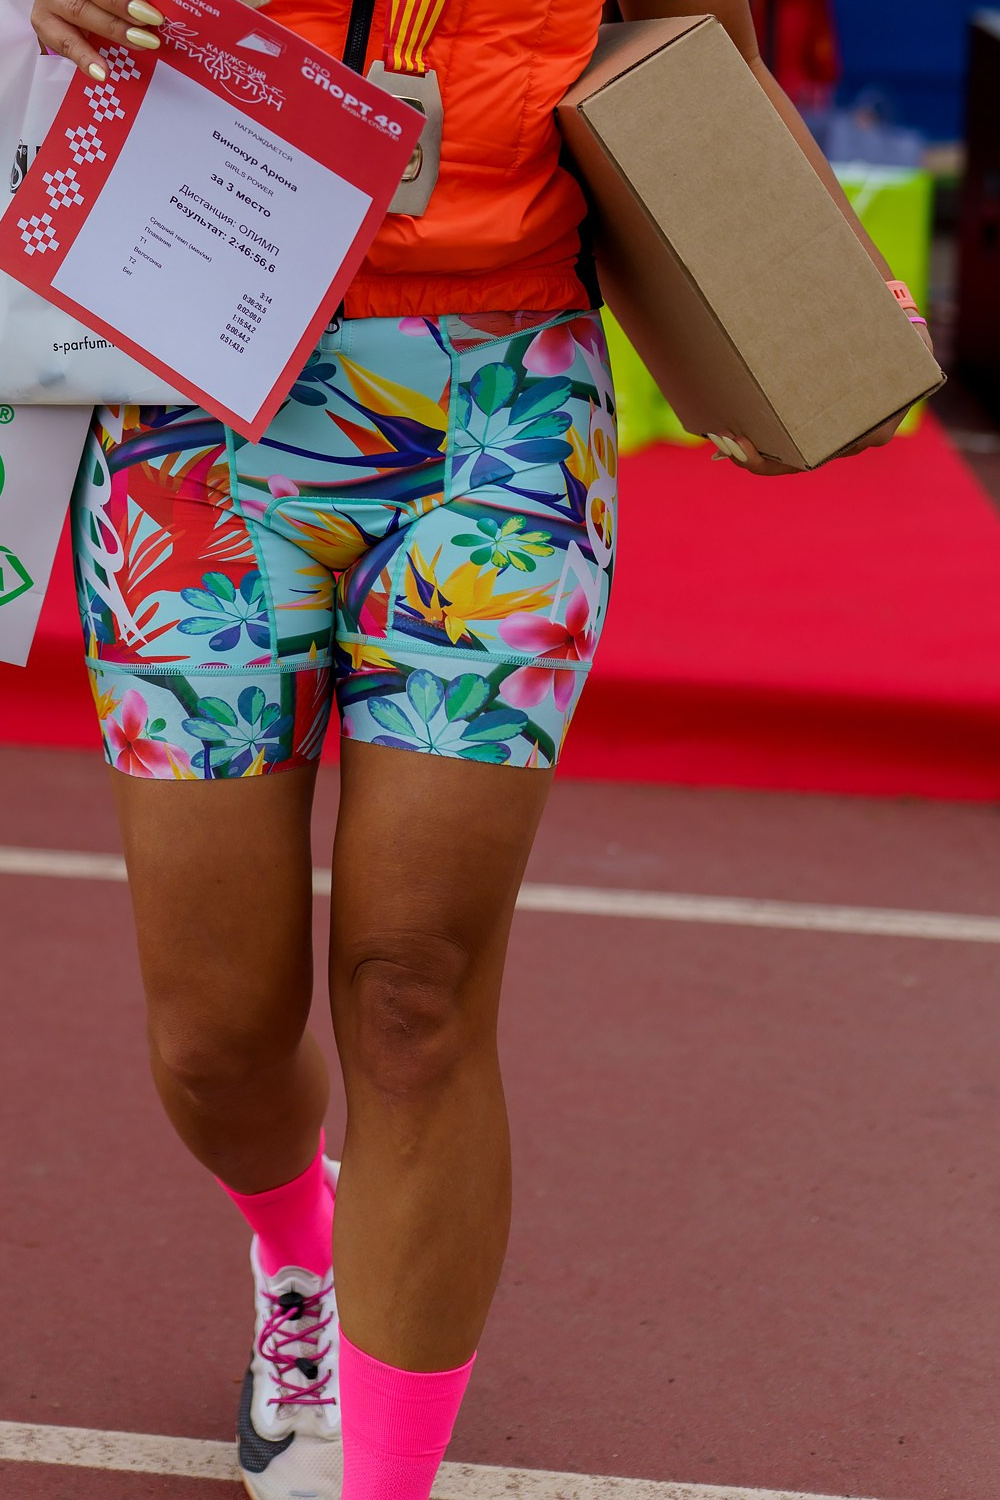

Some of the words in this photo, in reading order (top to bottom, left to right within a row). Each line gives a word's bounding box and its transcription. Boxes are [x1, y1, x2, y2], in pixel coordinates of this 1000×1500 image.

[303, 57, 331, 78] PRO
[301, 66, 373, 116] СПОРТ
[374, 115, 403, 136] 40
[234, 120, 293, 162] НАГРАЖДАЕТСЯ
[212, 130, 258, 166] Винокур
[260, 164, 298, 192] Арюна
[224, 160, 247, 178] GIRLS
[246, 175, 274, 197] POWER
[210, 173, 224, 186] за
[226, 182, 234, 192] 3
[235, 190, 271, 218] место
[149, 216, 175, 237] Средний
[174, 233, 189, 246] темп
[178, 184, 237, 228] Дистанция:
[238, 224, 280, 257] ОЛИМП
[144, 226, 172, 248] Плавание
[169, 195, 227, 240] Результат:
[228, 236, 276, 273] 2:46:56,6
[133, 246, 163, 269] Велогонка
[122, 266, 133, 276] Бег
[242, 293, 268, 314] 0:36:25,5
[260, 292, 273, 304] 3:14
[225, 323, 251, 344] 0:00:44,2
[232, 314, 257, 334] 1:15:54,2
[53, 336, 115, 355] s-parfum.
[219, 333, 245, 354] 0:51:43,6
